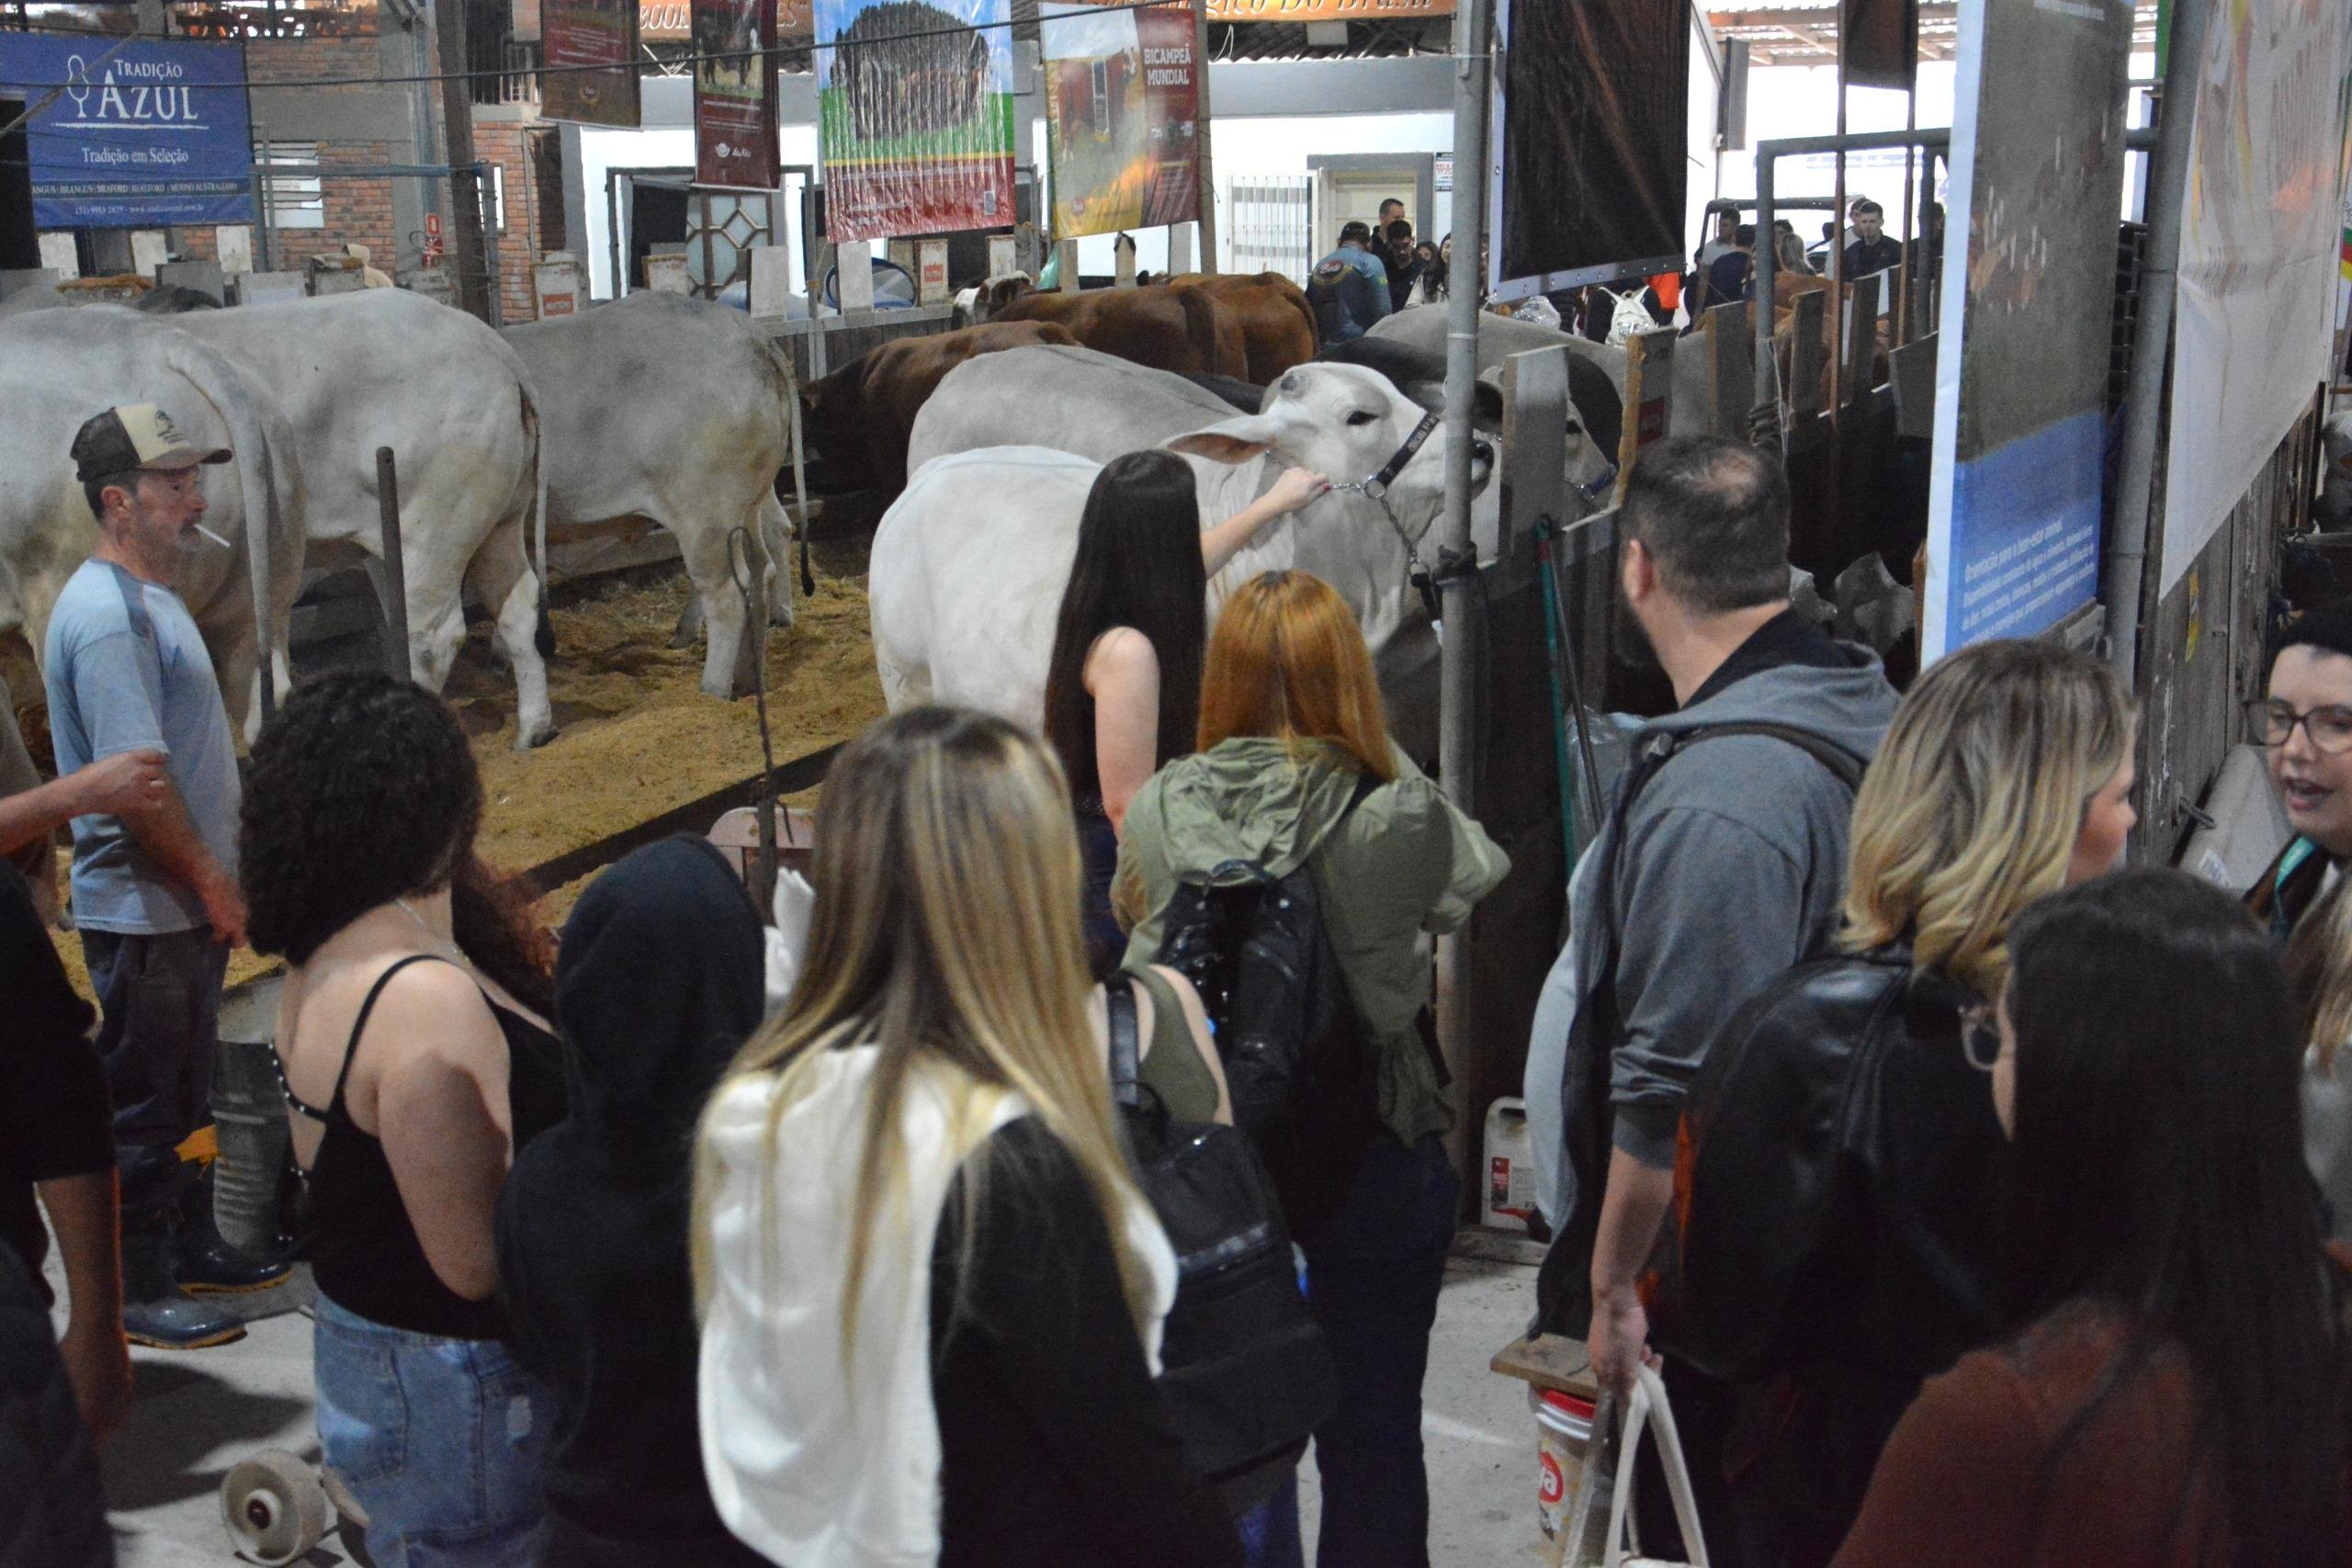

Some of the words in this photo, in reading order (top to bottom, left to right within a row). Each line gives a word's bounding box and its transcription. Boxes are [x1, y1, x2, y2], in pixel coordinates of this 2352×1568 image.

[1144, 43, 1192, 64] BICAMPEÃ
[114, 59, 183, 81] TRADIÇÃO
[1148, 68, 1190, 85] MUNDIAL
[96, 69, 198, 120] AZUL
[81, 147, 129, 165] Tradição
[131, 152, 147, 163] em
[149, 147, 189, 165] Seleção
[31, 185, 56, 194] ANGUS
[60, 185, 94, 194] BRANGUS
[96, 184, 129, 193] BRAFORD
[131, 184, 164, 193] HEREFORD
